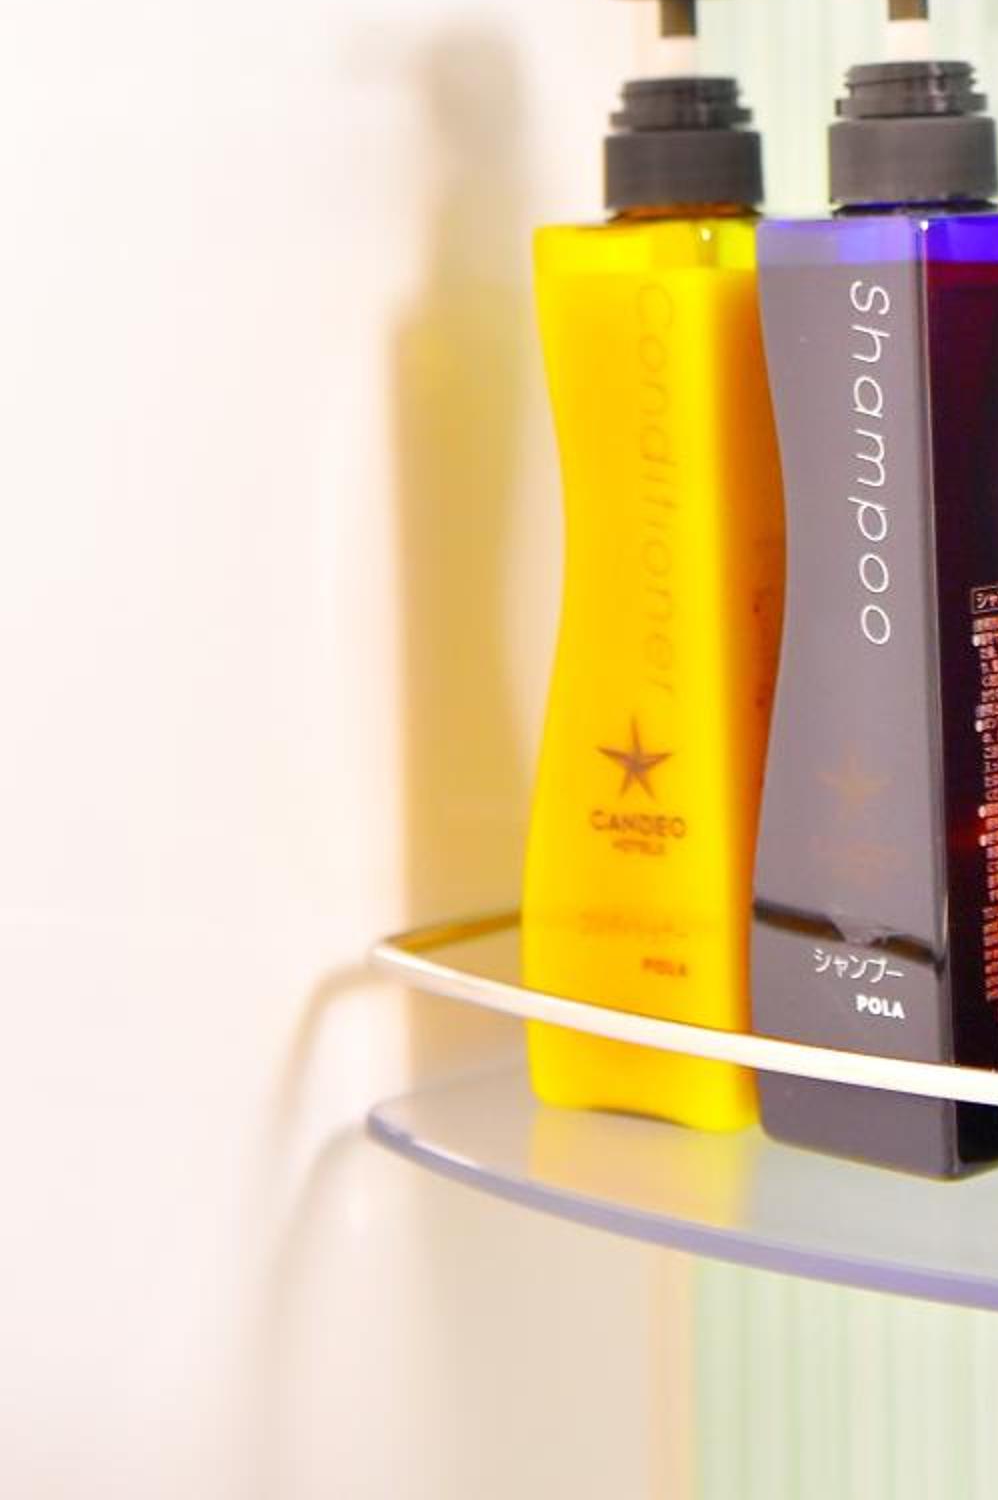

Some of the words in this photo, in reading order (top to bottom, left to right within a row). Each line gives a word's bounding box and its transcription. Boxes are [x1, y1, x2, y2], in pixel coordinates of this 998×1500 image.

[848, 280, 891, 645] Shampoo
[637, 283, 678, 694] Conditioner
[590, 807, 688, 839] CANDEO
[812, 949, 905, 983] シャンプー
[855, 994, 905, 1019] POLA
